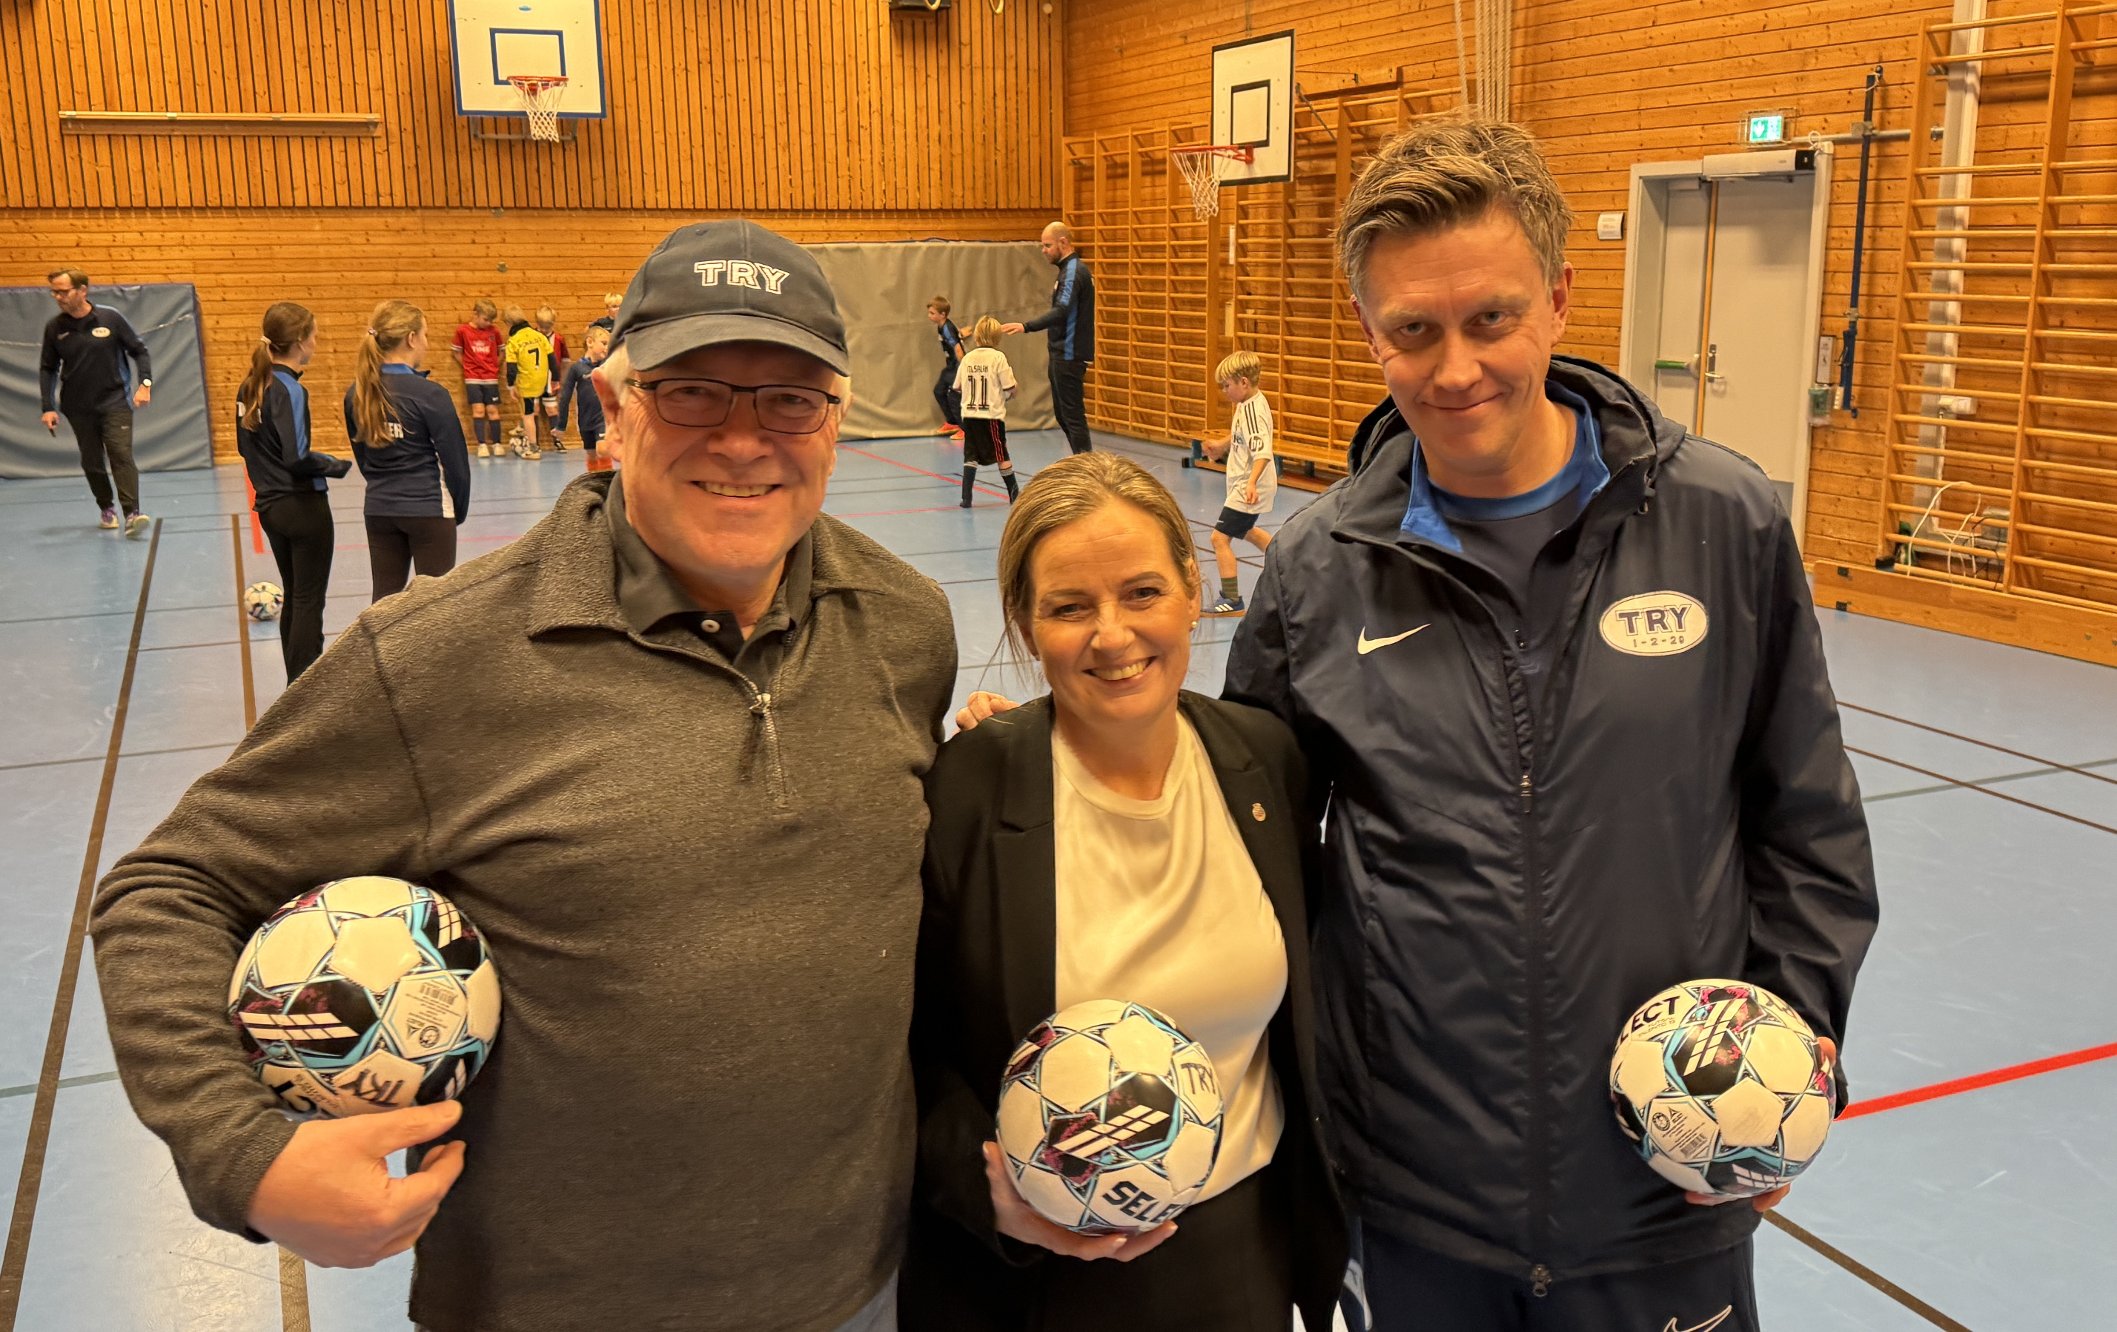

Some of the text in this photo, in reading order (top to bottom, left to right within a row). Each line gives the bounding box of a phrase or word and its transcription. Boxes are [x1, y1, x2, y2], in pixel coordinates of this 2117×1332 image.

[694, 260, 790, 294] TRY
[527, 348, 540, 367] 7
[966, 375, 990, 410] 11
[1615, 604, 1692, 636] TRY
[1102, 1181, 1184, 1223] SELE
